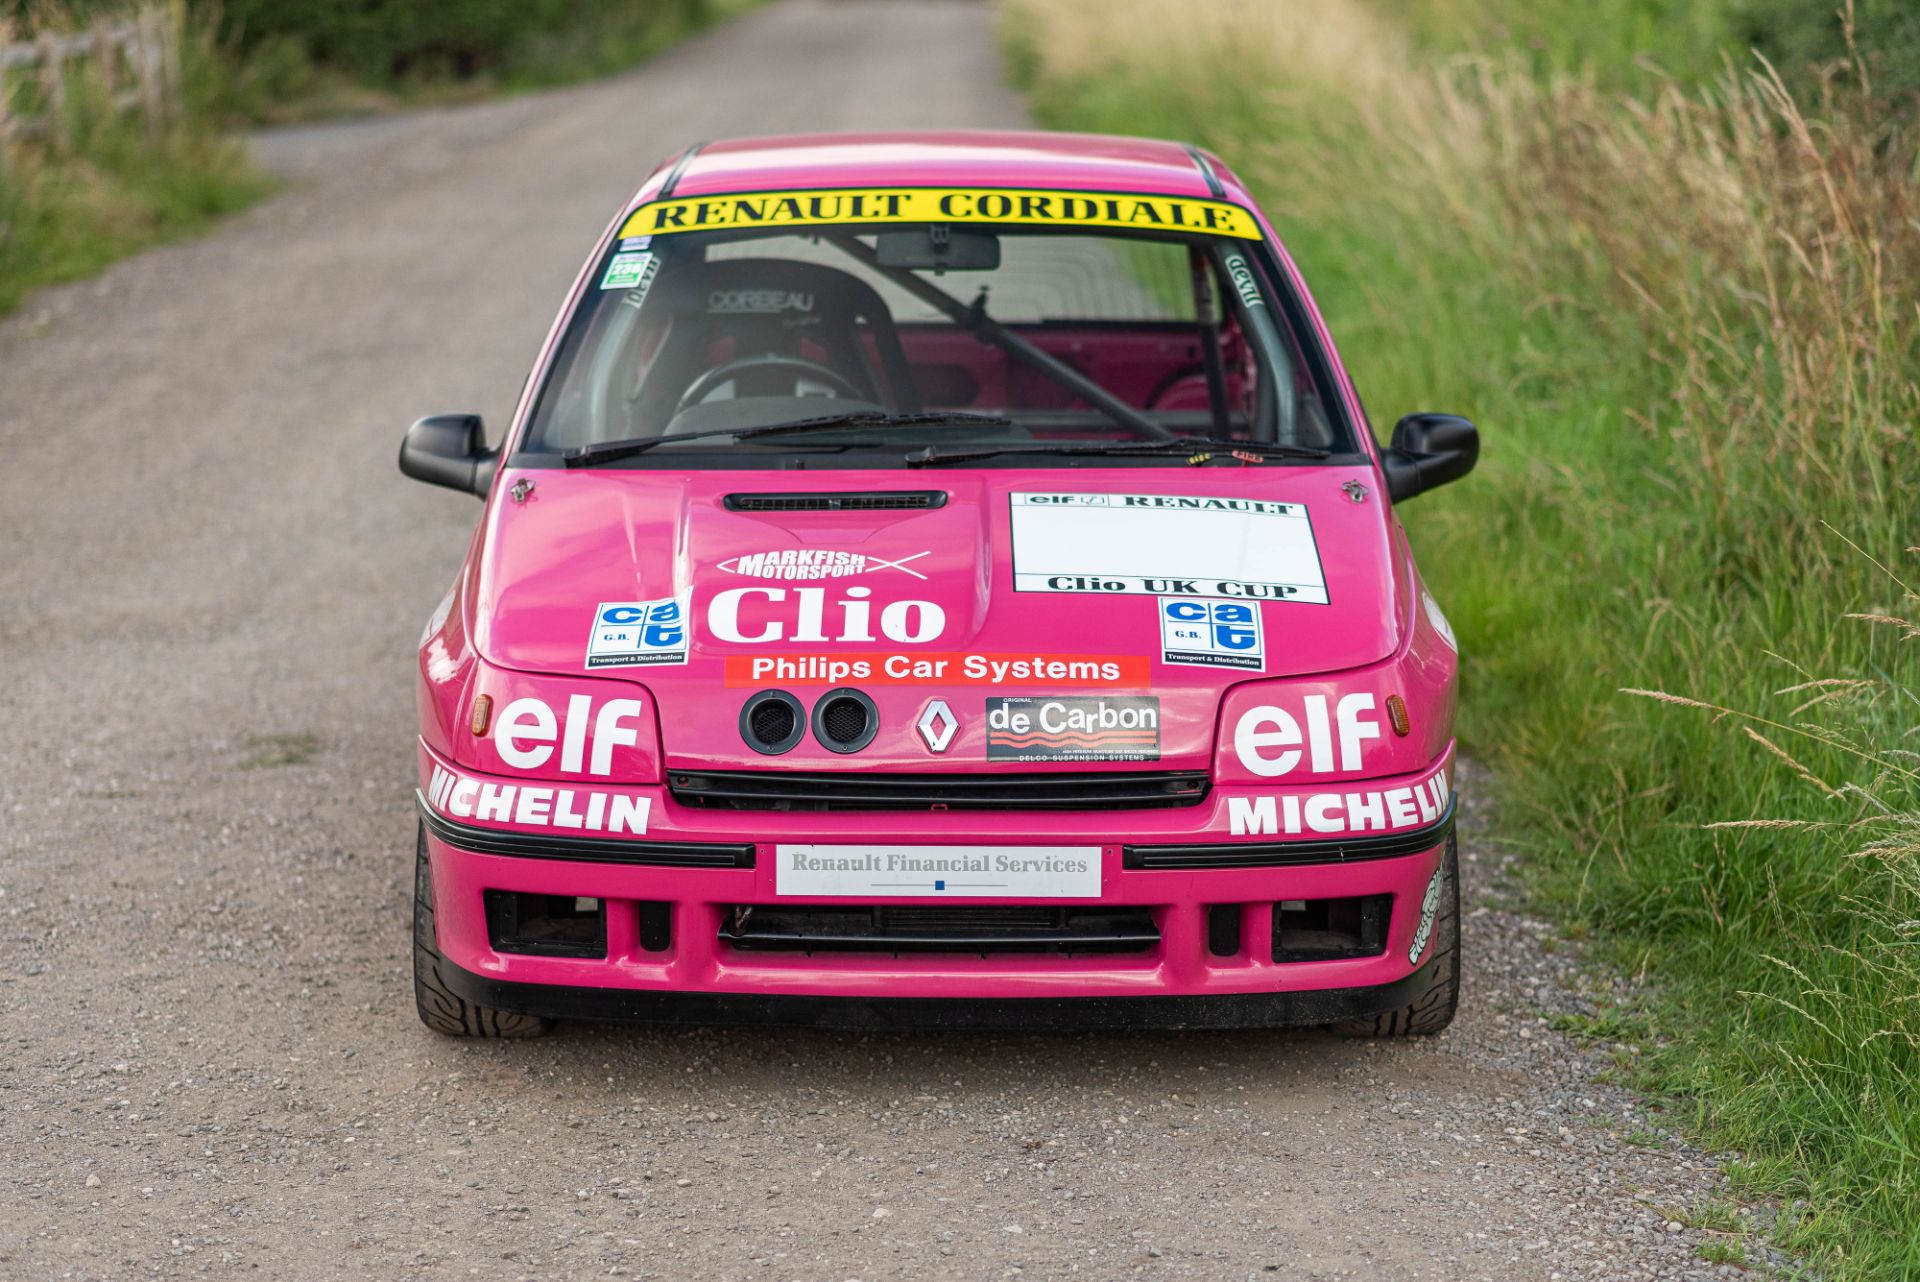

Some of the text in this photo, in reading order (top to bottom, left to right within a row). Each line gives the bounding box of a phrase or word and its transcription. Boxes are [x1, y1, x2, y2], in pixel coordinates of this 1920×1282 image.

[653, 194, 1236, 231] RENAULT CORDIALE
[708, 289, 815, 312] CORBEAU
[1029, 496, 1293, 515] elf RENAULT
[737, 550, 866, 574] MARKFISH
[1048, 577, 1298, 598] Clio UK CUP
[707, 586, 946, 644] Clio
[592, 655, 629, 664] Transport
[637, 654, 683, 662] Distribution
[752, 655, 1121, 684] Philips Car Systems
[1167, 653, 1206, 662] Transport
[1214, 656, 1260, 666] Distribution
[989, 702, 1157, 734] de Carbon
[494, 694, 642, 776] elf
[1234, 692, 1381, 777] elf
[428, 764, 652, 835] MICHELIN
[1228, 768, 1449, 836] MICHELIN
[791, 853, 1088, 873] Renault Financial Services
